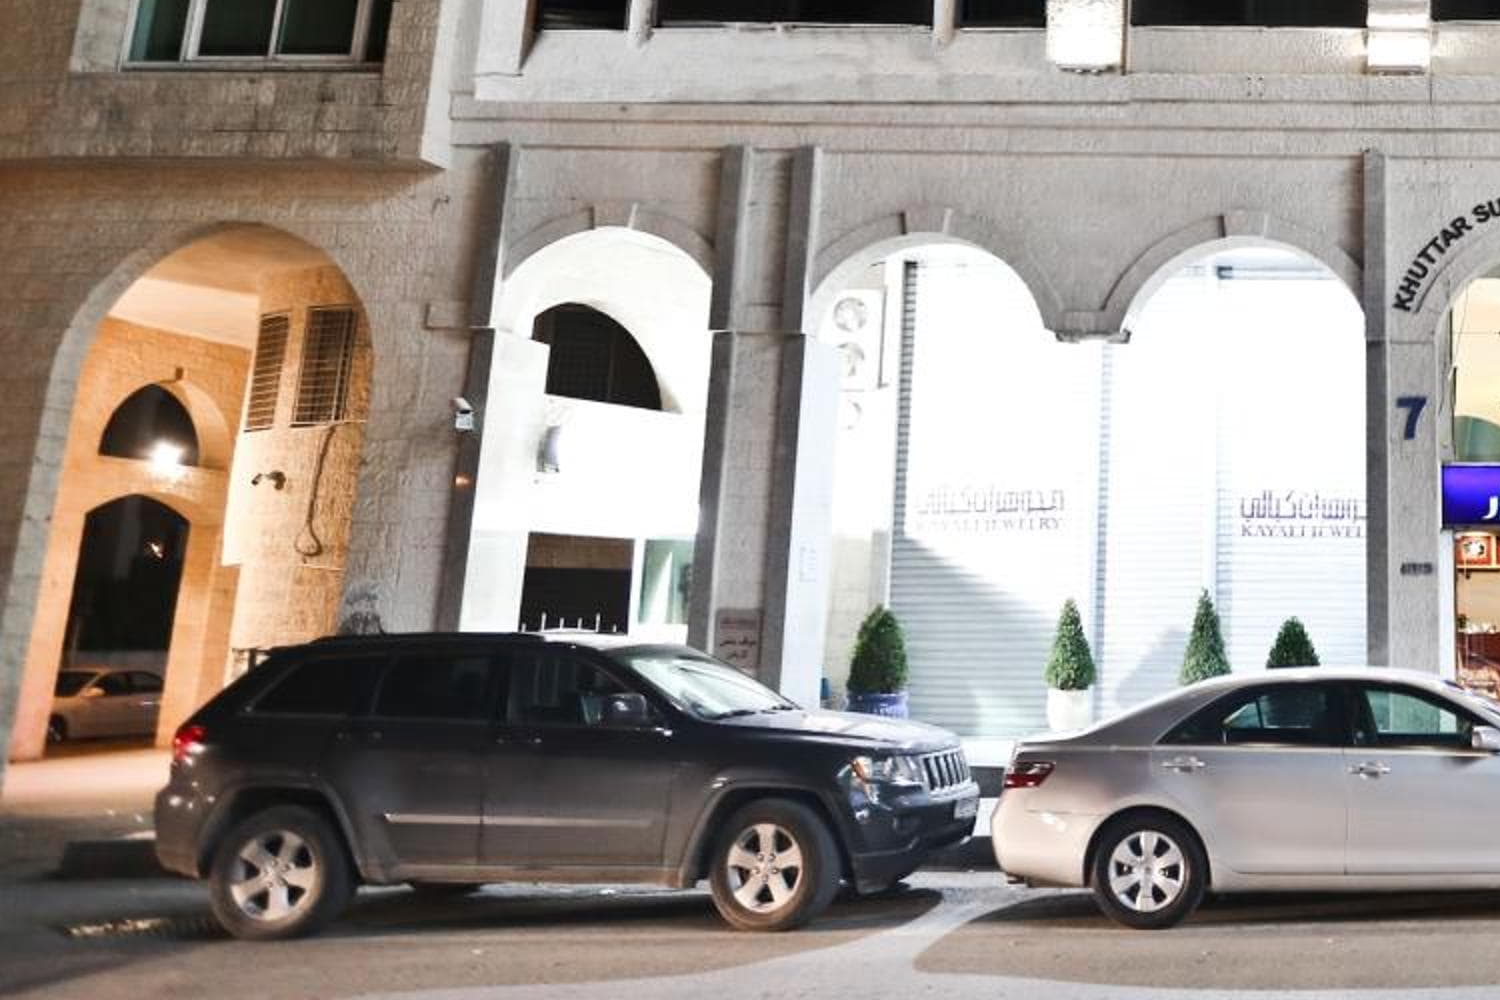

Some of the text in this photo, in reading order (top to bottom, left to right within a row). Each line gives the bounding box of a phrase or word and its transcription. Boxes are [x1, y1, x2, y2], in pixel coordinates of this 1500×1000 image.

[1392, 216, 1473, 313] KHUTTAR
[1396, 397, 1427, 441] 7
[1241, 523, 1362, 539] KAYALI JEWEL
